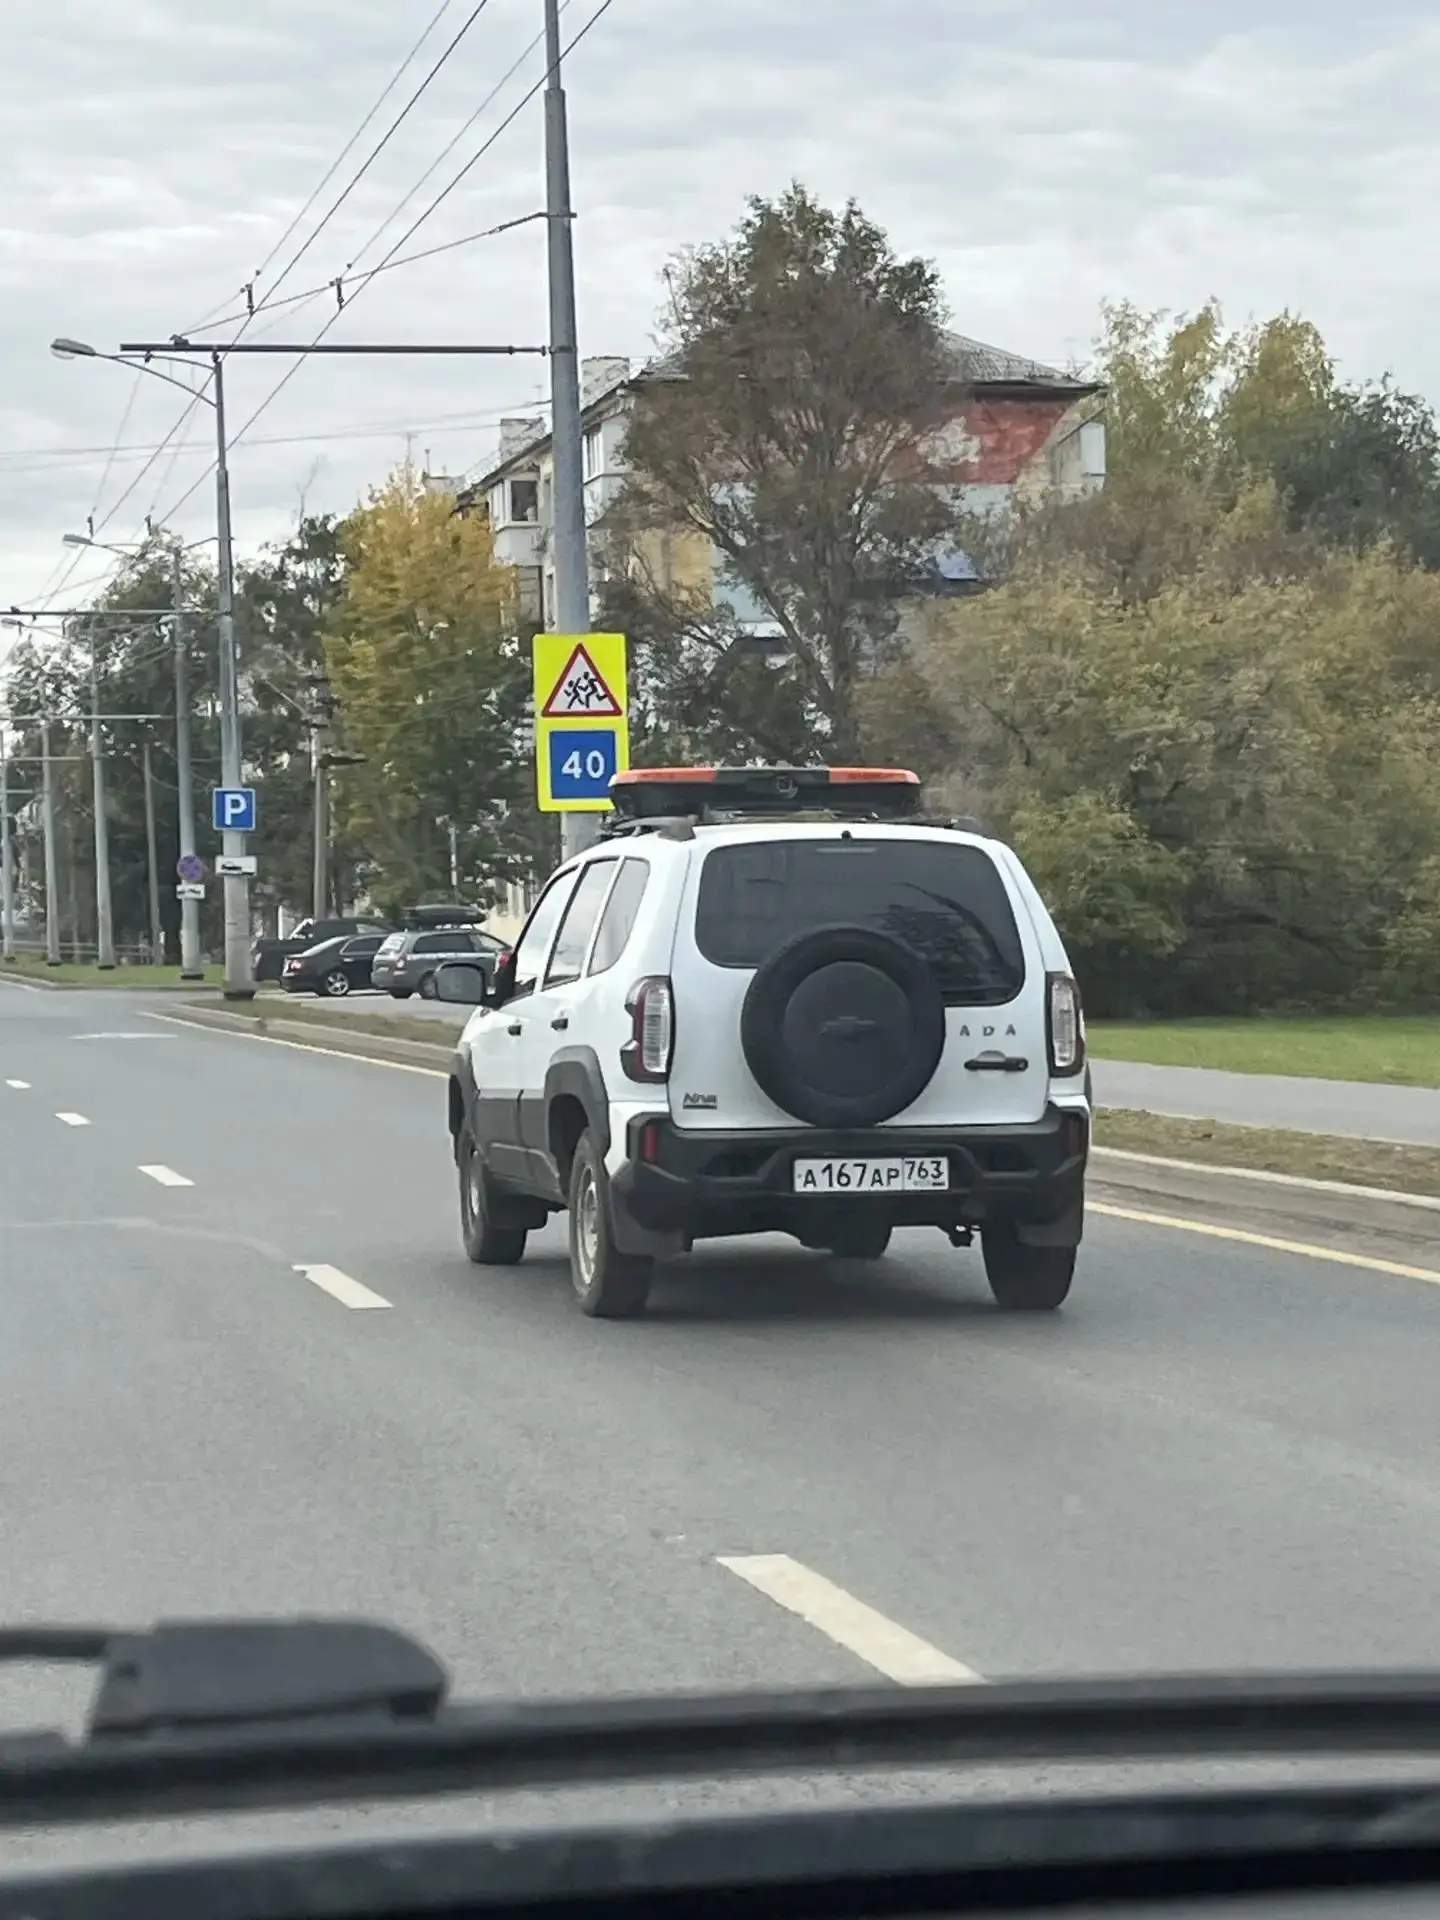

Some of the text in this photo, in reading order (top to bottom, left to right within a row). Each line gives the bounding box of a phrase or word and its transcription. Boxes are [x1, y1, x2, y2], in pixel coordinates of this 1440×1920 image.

[561, 750, 605, 779] 40
[224, 793, 247, 826] P
[959, 1024, 1016, 1037] ADA
